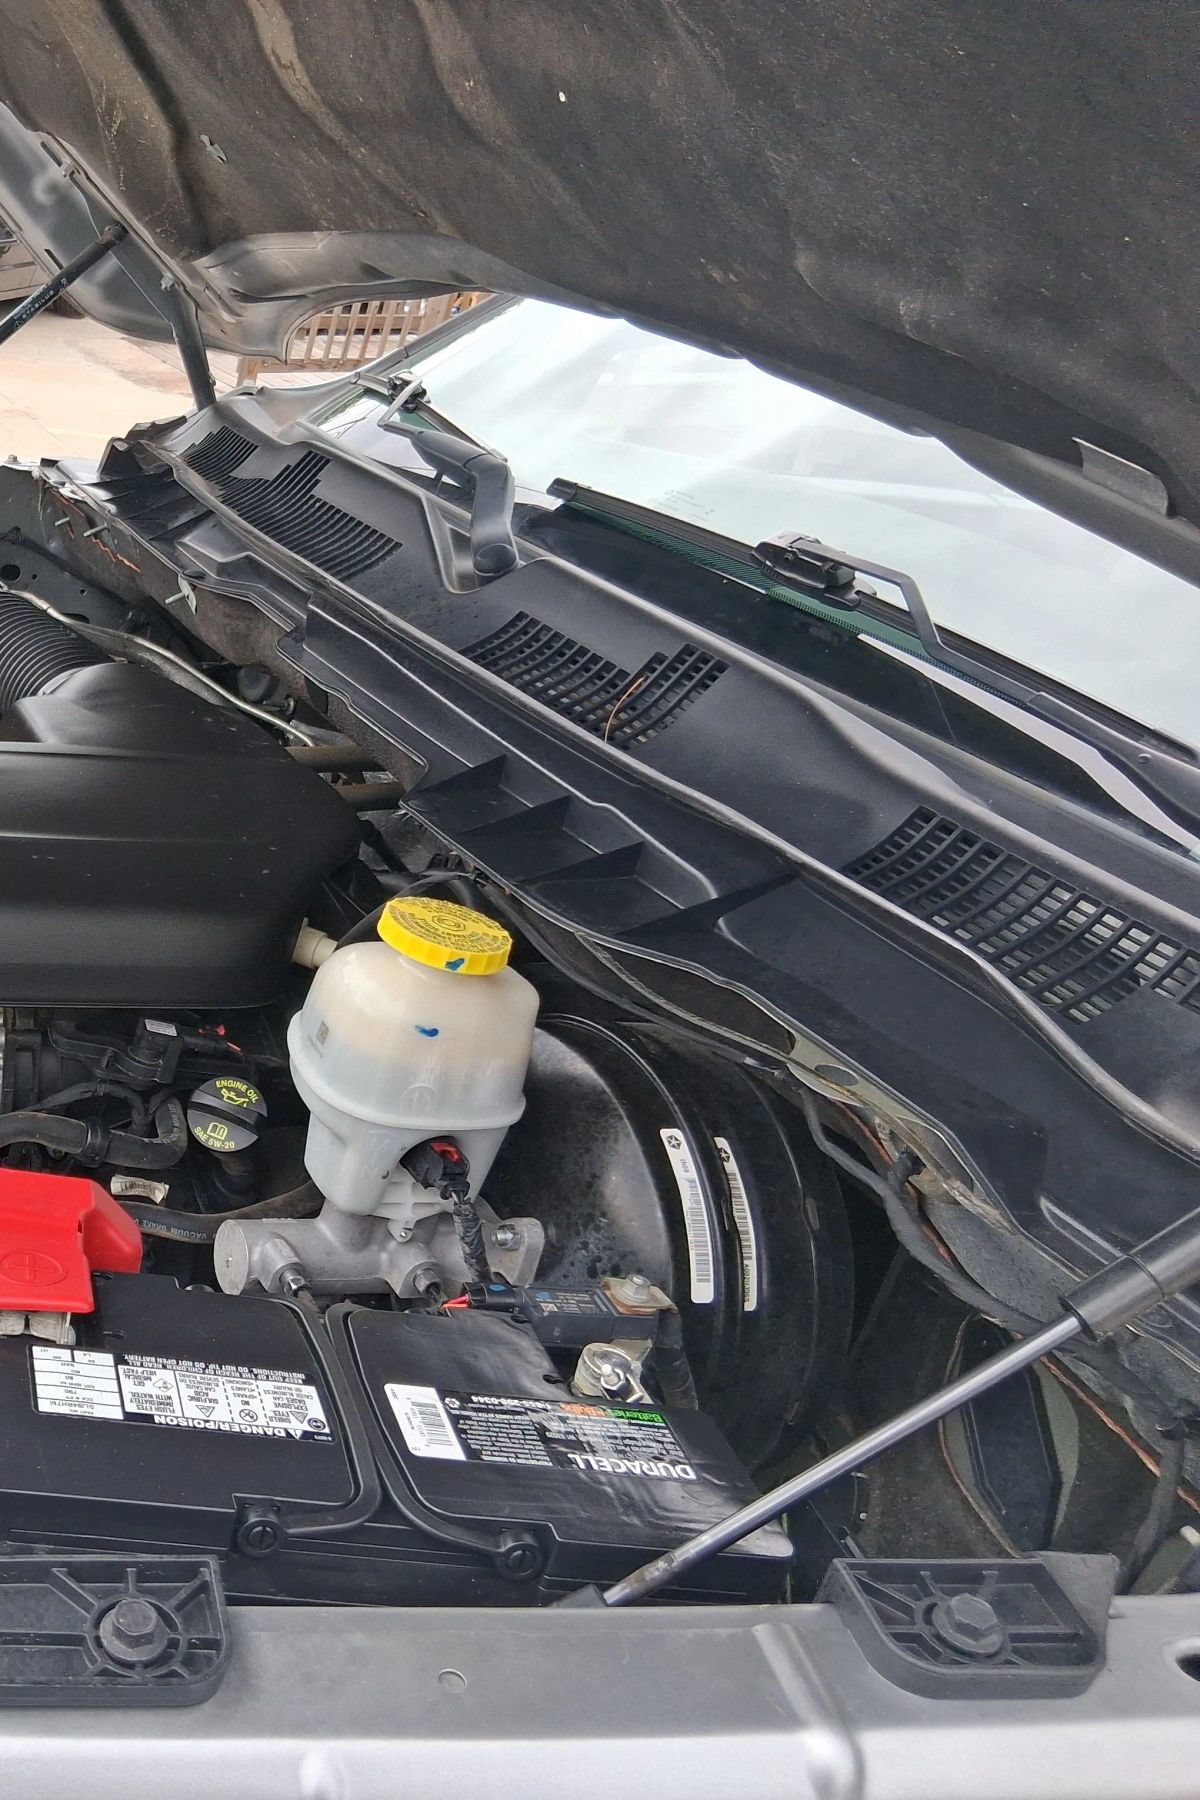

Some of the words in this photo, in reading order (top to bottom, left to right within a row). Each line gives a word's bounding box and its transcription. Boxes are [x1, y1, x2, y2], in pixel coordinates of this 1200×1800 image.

[22, 290, 54, 318] STABILUS
[215, 1079, 248, 1092] ENGINE
[246, 1089, 259, 1104] OIL
[194, 1126, 209, 1142] SAE
[207, 1139, 235, 1149] 5W-20
[142, 1219, 167, 1231] BRAKE
[170, 1227, 207, 1239] VACUUM
[122, 1353, 155, 1363] BATTERY.
[130, 1398, 173, 1407] IMMEDIATELY
[188, 1395, 219, 1404] SULFURIC
[273, 1402, 308, 1411] EXPLOSIVE
[567, 1454, 697, 1480] DURACELL
